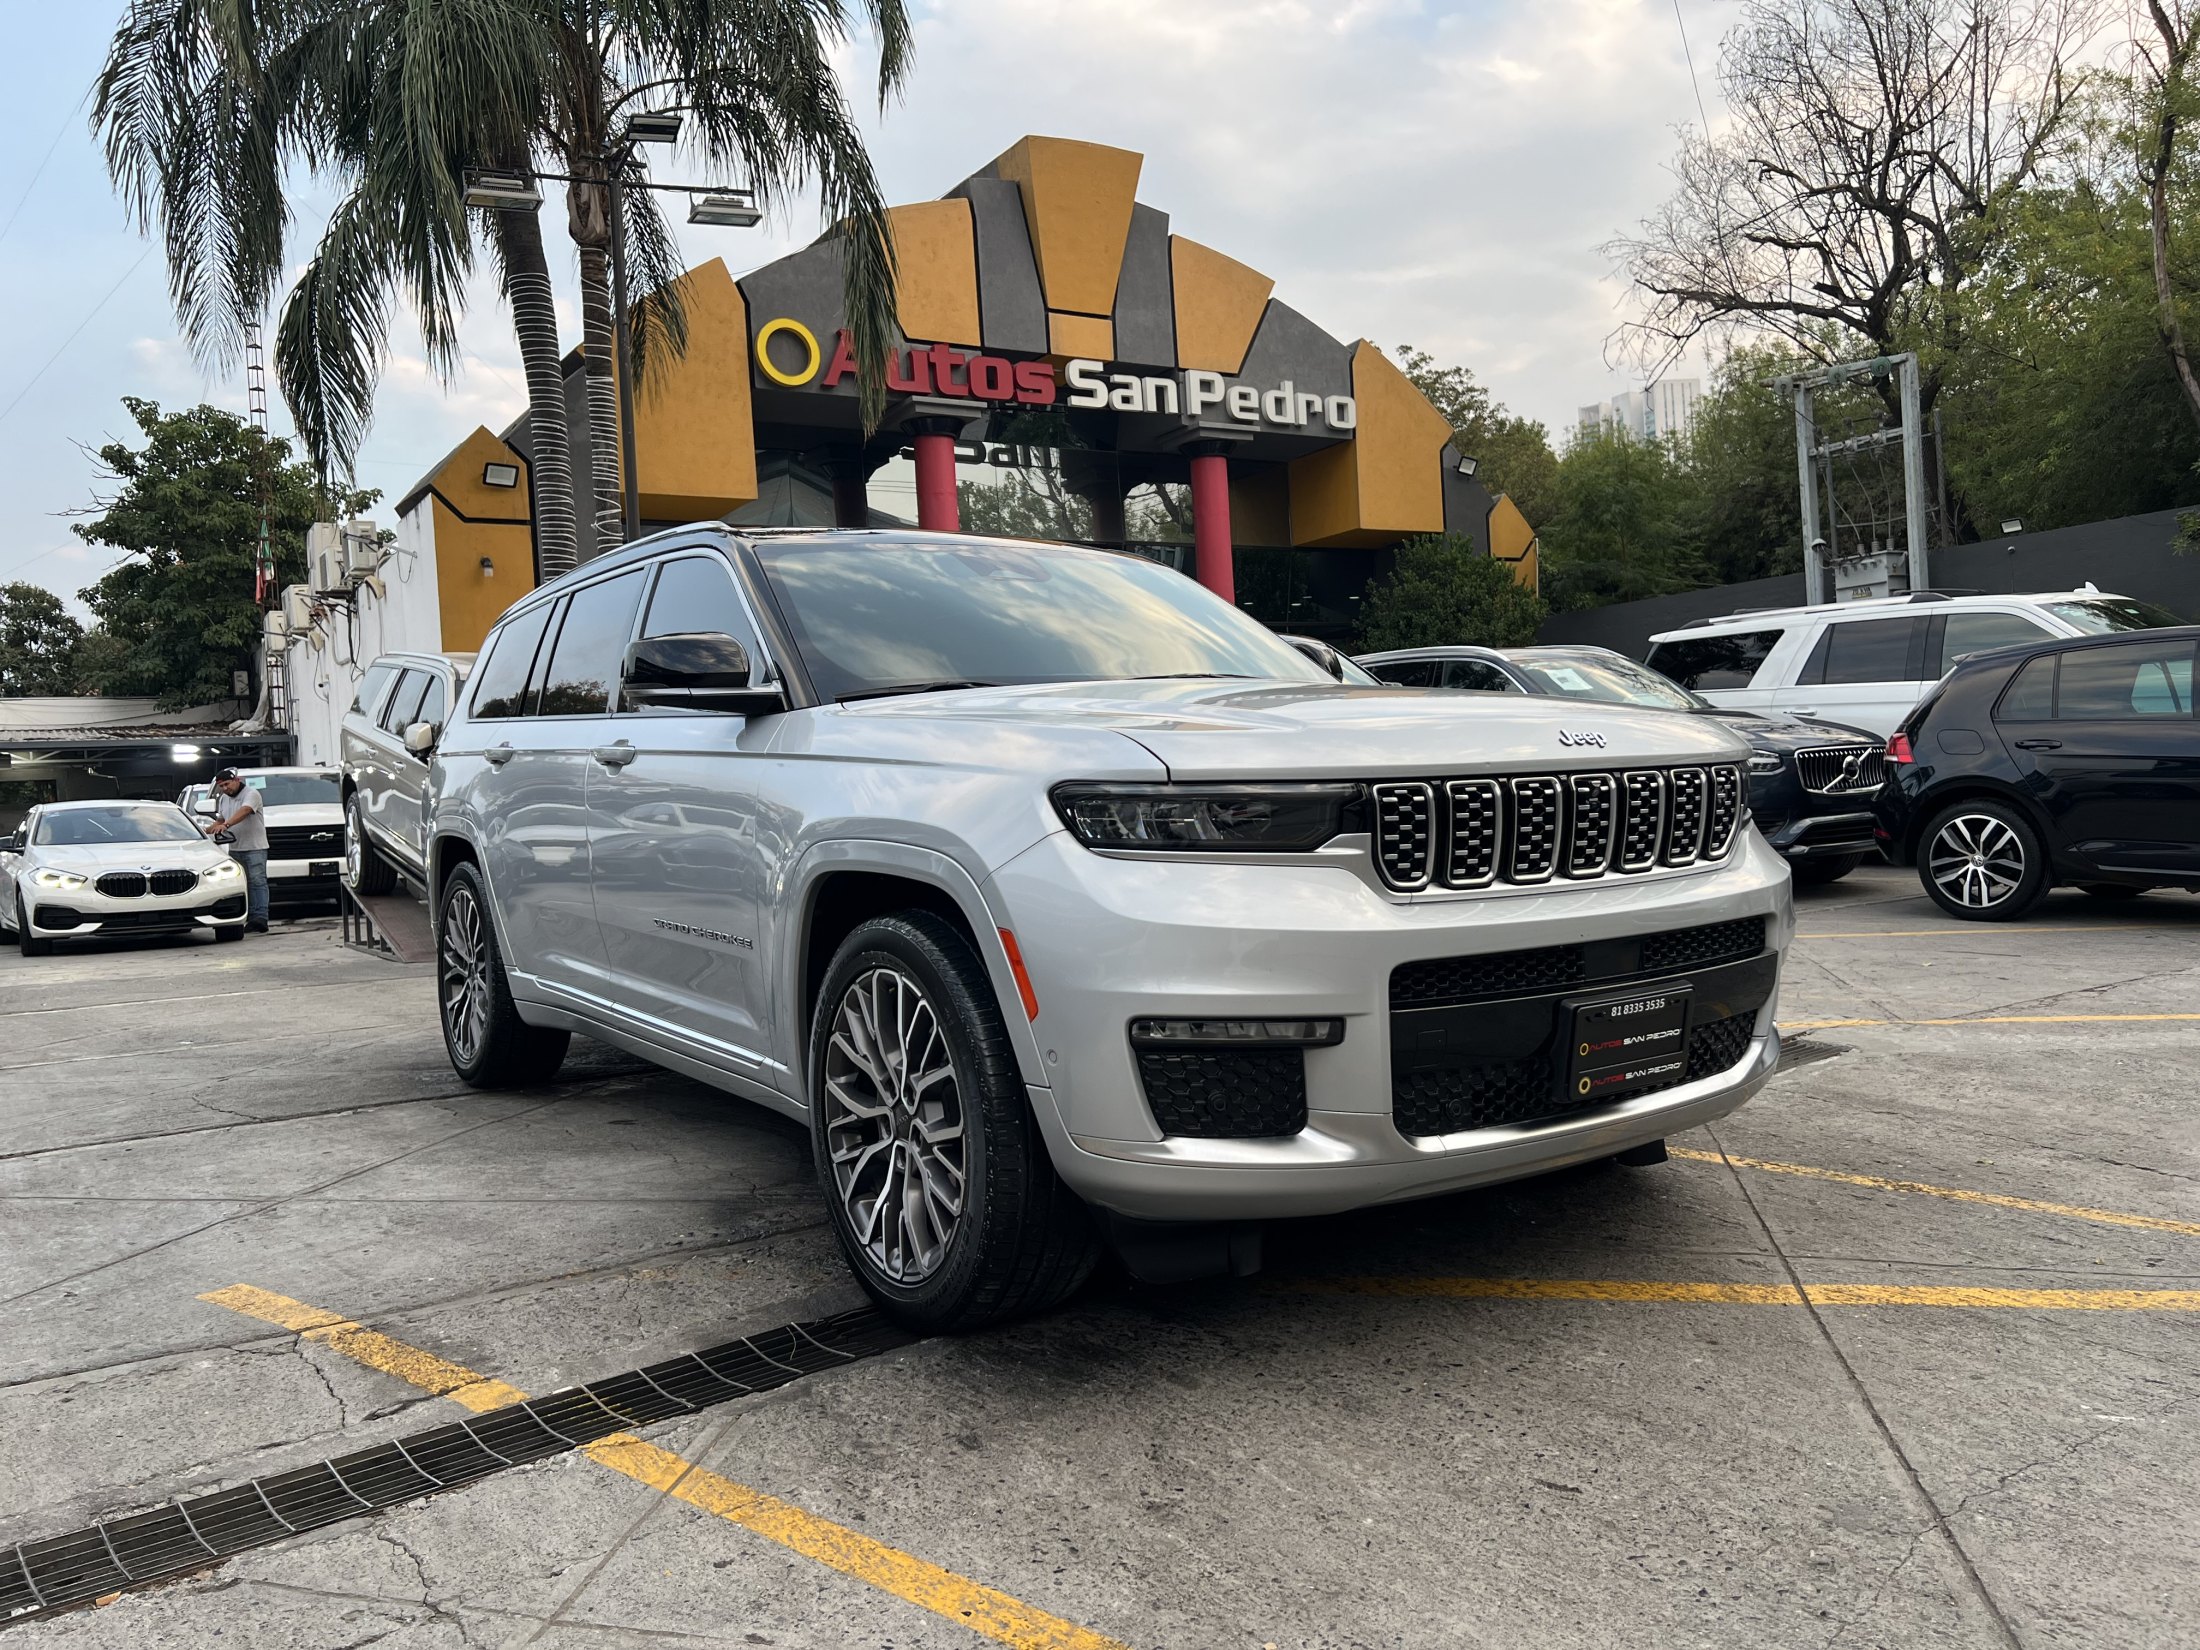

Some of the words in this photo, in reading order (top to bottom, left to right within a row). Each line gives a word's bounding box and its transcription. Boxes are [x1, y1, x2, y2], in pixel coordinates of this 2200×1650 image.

[823, 327, 1056, 405] Autos
[1559, 728, 1607, 749] Jeep
[1611, 1006, 1622, 1017] 81
[1623, 1002, 1644, 1015] 8335
[1645, 998, 1666, 1011] 3535
[1589, 1039, 1623, 1051] AUTOS
[1623, 1034, 1645, 1046] SAN
[1645, 1028, 1682, 1041] PEDRO
[1591, 1073, 1626, 1087] AUTOS
[1625, 1069, 1647, 1080] SAN
[1647, 1062, 1682, 1075] PEDRO
